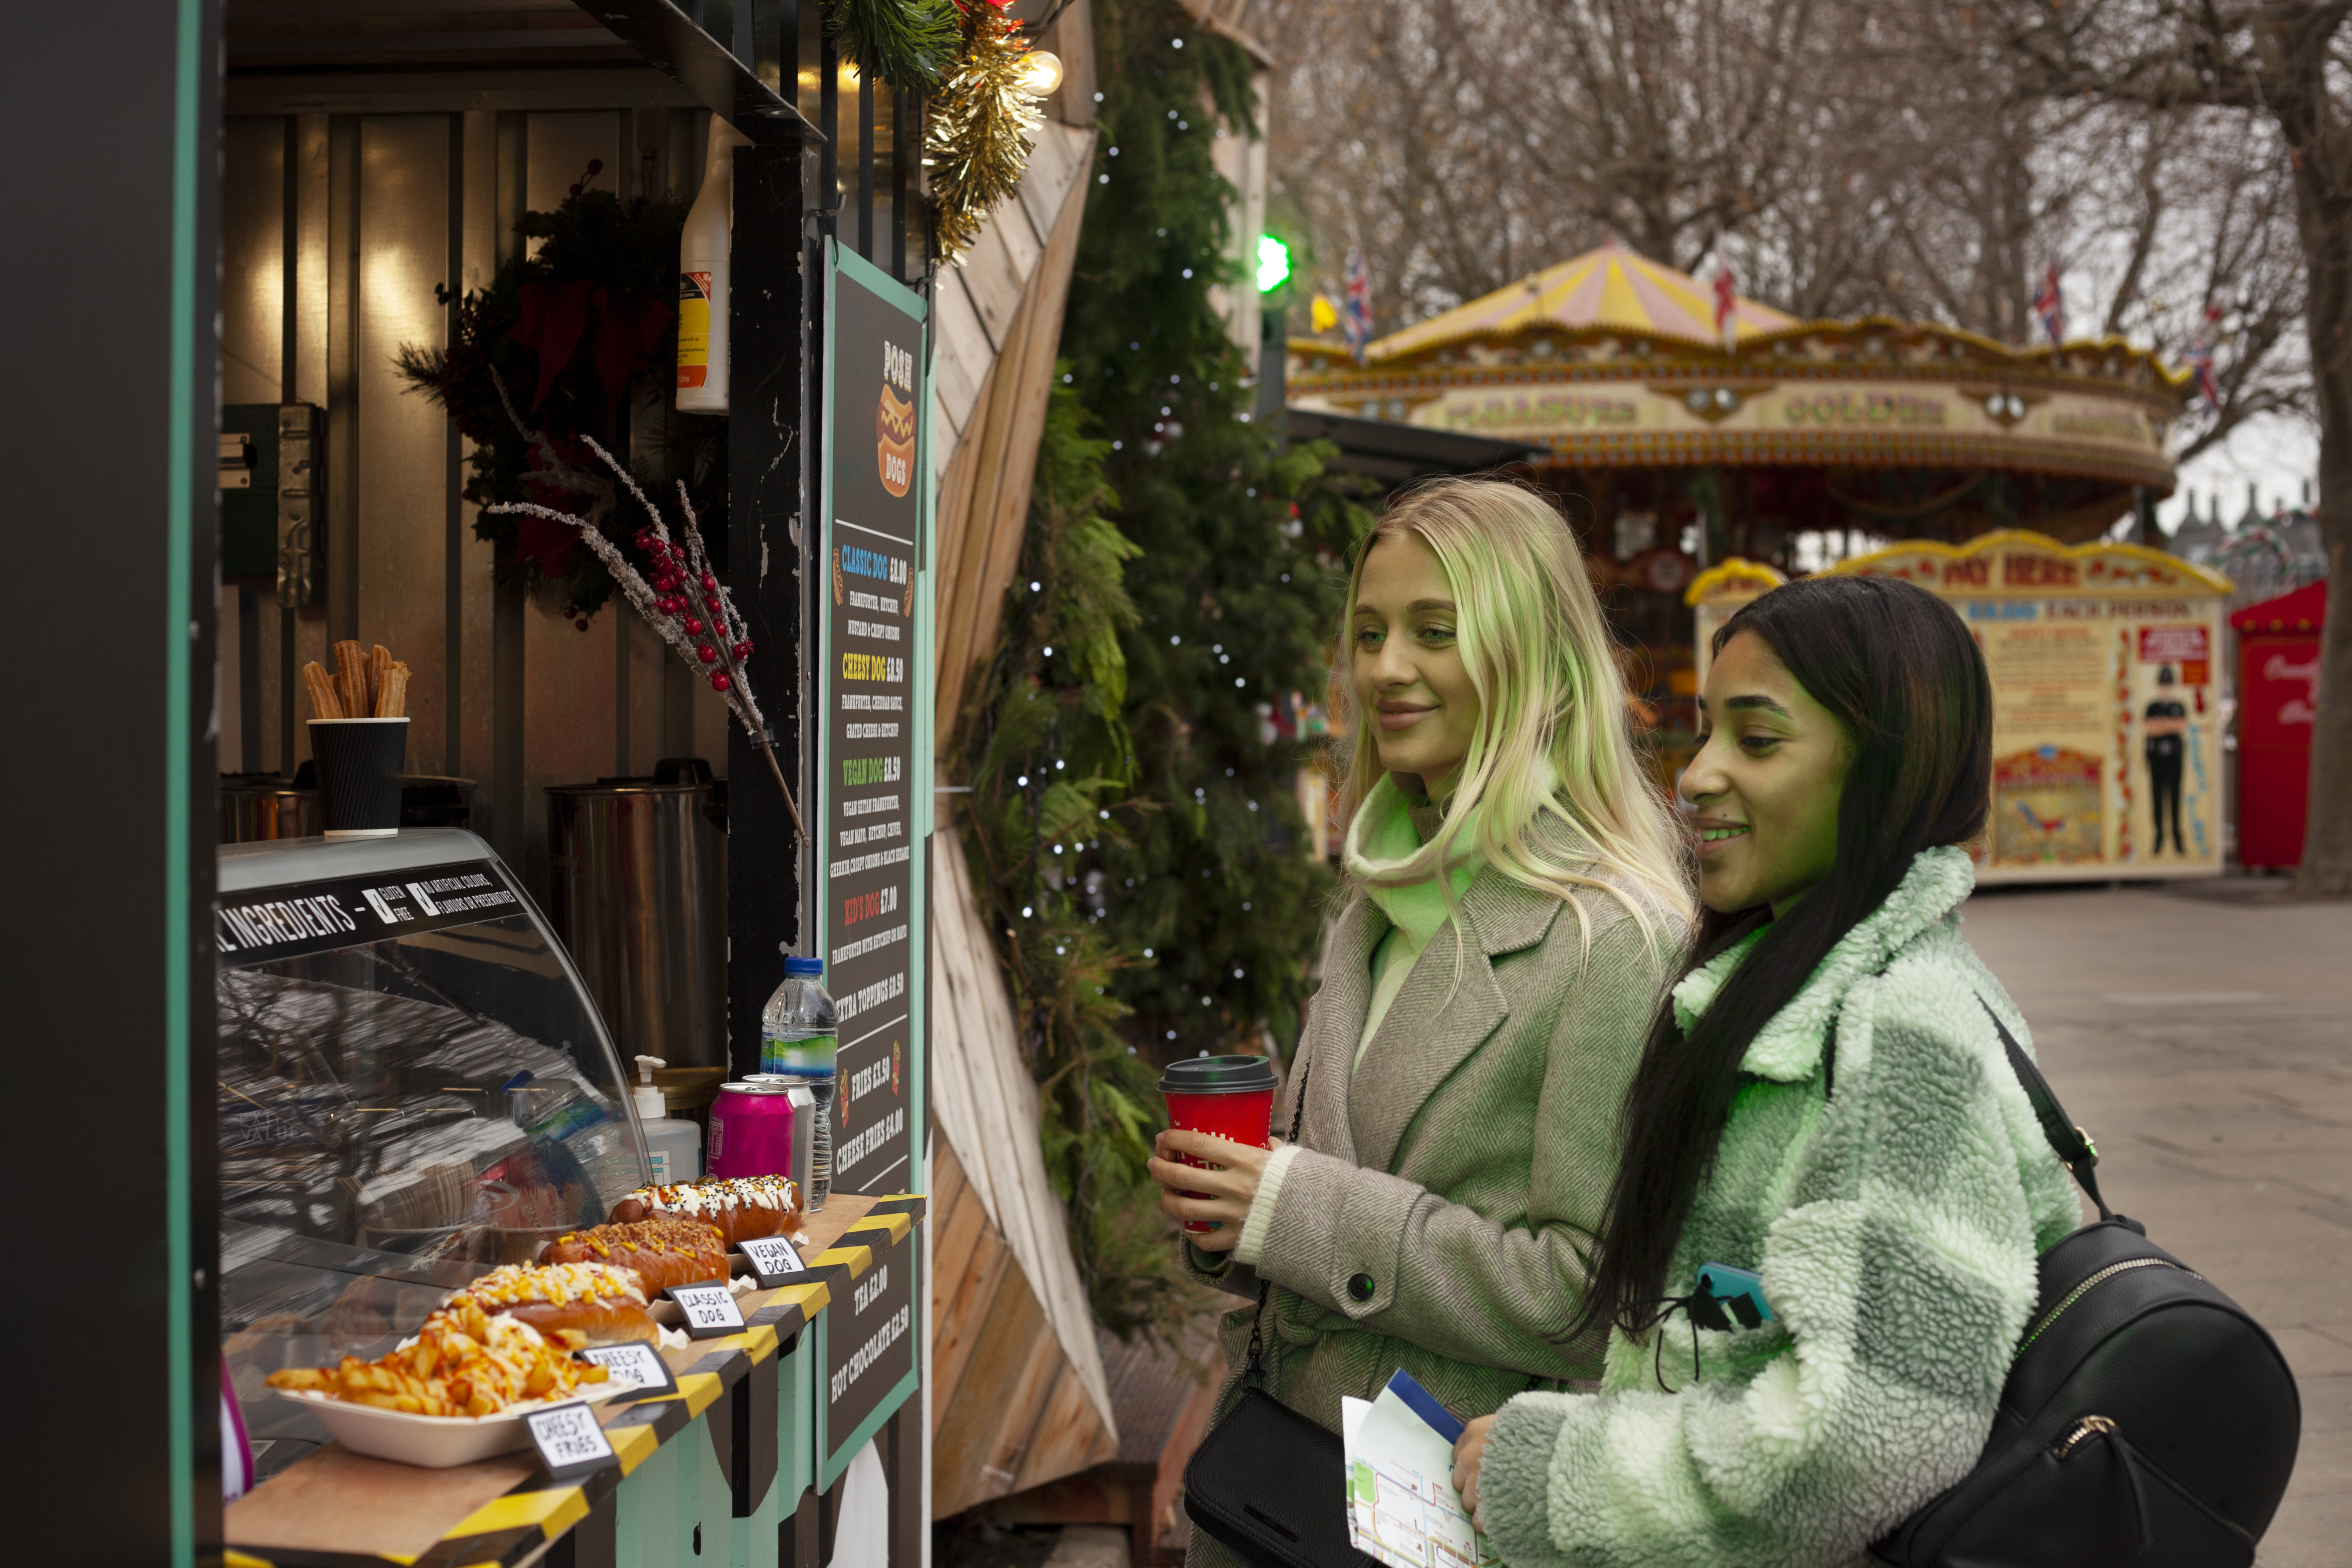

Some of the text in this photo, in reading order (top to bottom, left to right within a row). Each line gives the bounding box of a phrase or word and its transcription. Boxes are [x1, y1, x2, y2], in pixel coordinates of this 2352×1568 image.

[884, 340, 913, 392] POSH
[886, 453, 906, 486] DOGS
[842, 544, 907, 585] CLASSIC DOG £8.00
[850, 590, 899, 616] FRANKFURTER, KETCHUP,
[848, 619, 900, 641] MUSTARD & CRISPY ONIONS
[843, 652, 903, 683] CHEESY DOG £8.50
[842, 694, 903, 712] FRANKFURTER, CHEDDAR SAUCE,
[846, 722, 899, 739] GRATED CHEESE & KETCHUP
[843, 756, 901, 786] VEGAN DOG £8.50
[843, 794, 900, 817] VEGAN SEITAN FRANKFURTER,
[840, 821, 902, 847] VEGAN MAYO, KETCHUP, CHIVES,
[865, 852, 880, 870] ONIONS
[880, 851, 883, 866] &
[883, 848, 895, 865] BLACK
[895, 845, 909, 863] SESAME
[378, 885, 406, 901] GLUTEN
[420, 873, 493, 894] NO ARTIFICIAL COLOURS,
[393, 906, 415, 922] FREE
[435, 890, 516, 914] FLAVOURS OR PRESERVATIVES
[844, 885, 897, 927] KID'S DOG £7.00
[219, 894, 356, 950] INGREDIENTS
[832, 924, 907, 965] FRANKFURTER WITH KETCHUP OR MAYO
[836, 971, 904, 1023] EXTRA TOPPINGS £0.50
[851, 1055, 890, 1102] FRIES £3.50
[836, 1107, 903, 1175] CHEESE FRIES £4.00
[749, 1237, 788, 1258] VEGAN
[764, 1259, 792, 1275] DOG
[681, 1290, 729, 1307] CLASSIC
[854, 1264, 887, 1316] TEA £2.00
[700, 1308, 725, 1325] DOG
[831, 1304, 909, 1404] HOT CHOCOLATE £2.50
[535, 1411, 585, 1441] CHEESY
[555, 1435, 597, 1457] FRIES
